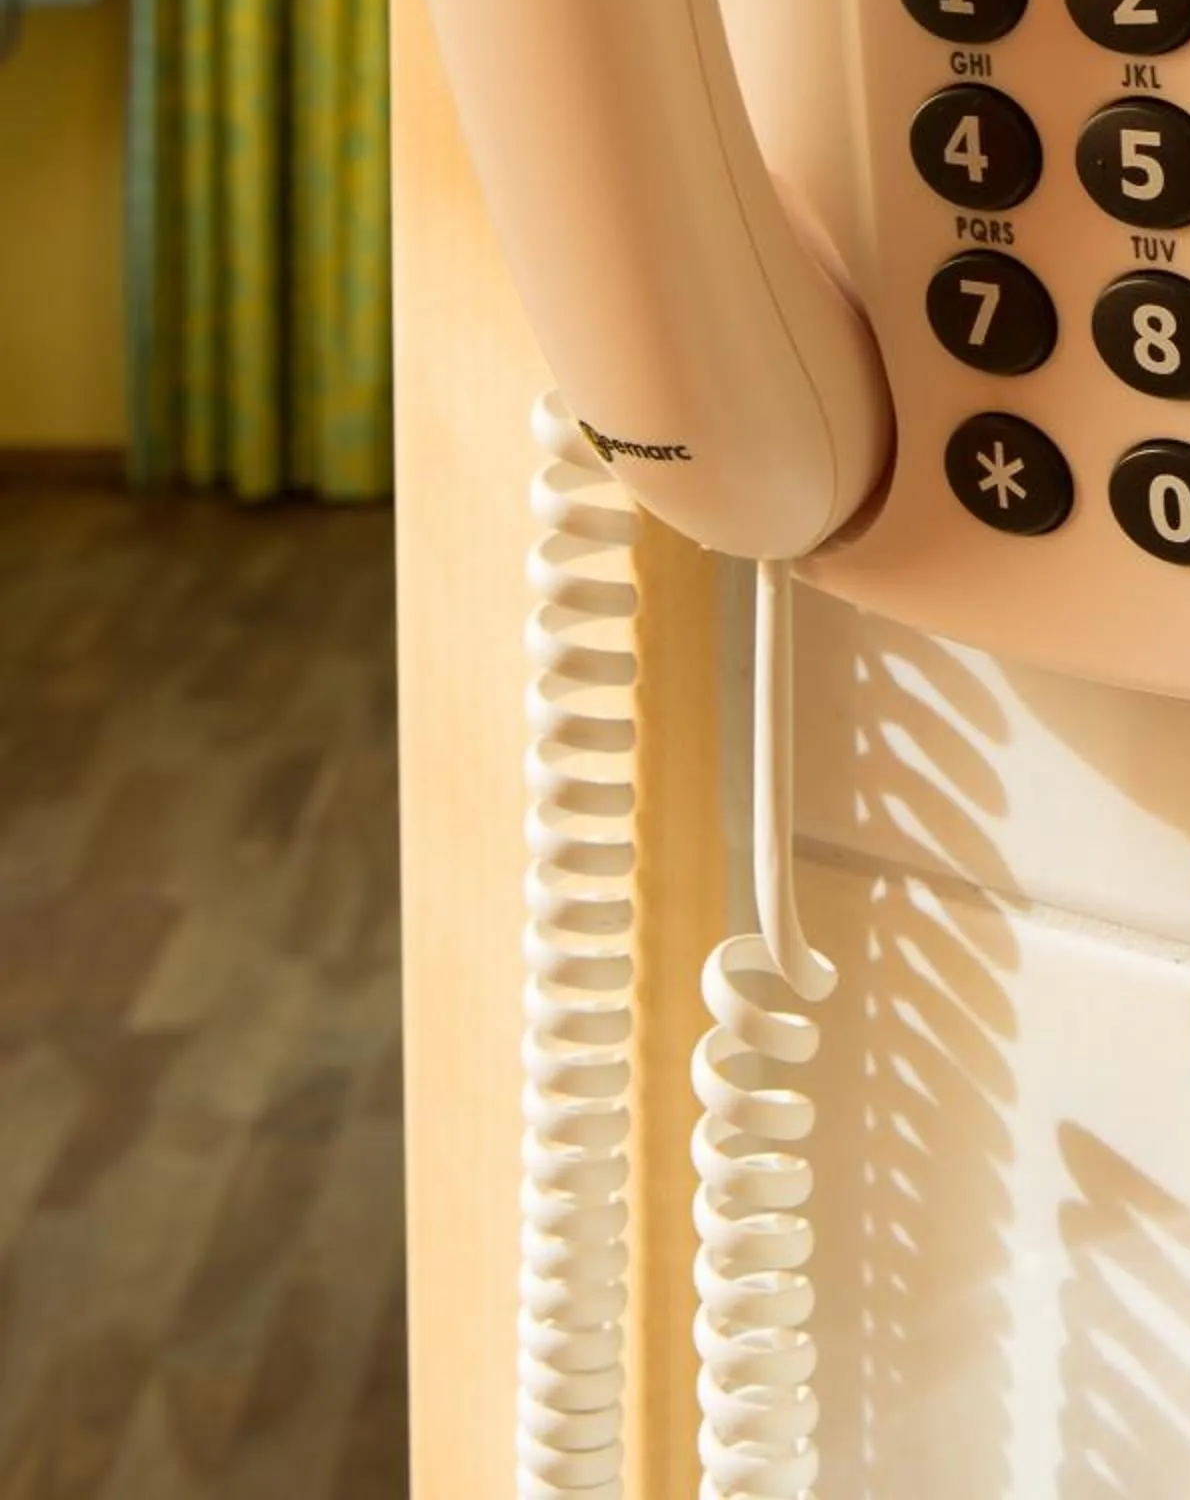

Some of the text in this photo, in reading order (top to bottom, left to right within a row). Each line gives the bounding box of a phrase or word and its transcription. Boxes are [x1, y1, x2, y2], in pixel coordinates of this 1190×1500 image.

[949, 50, 992, 77] GHI
[1121, 63, 1162, 90] JKL
[943, 115, 989, 183] 4
[1120, 128, 1165, 201] 5
[955, 215, 1015, 246] PQRS
[1130, 235, 1176, 263] TUV
[959, 279, 1000, 346] 7
[1132, 303, 1181, 375] 8
